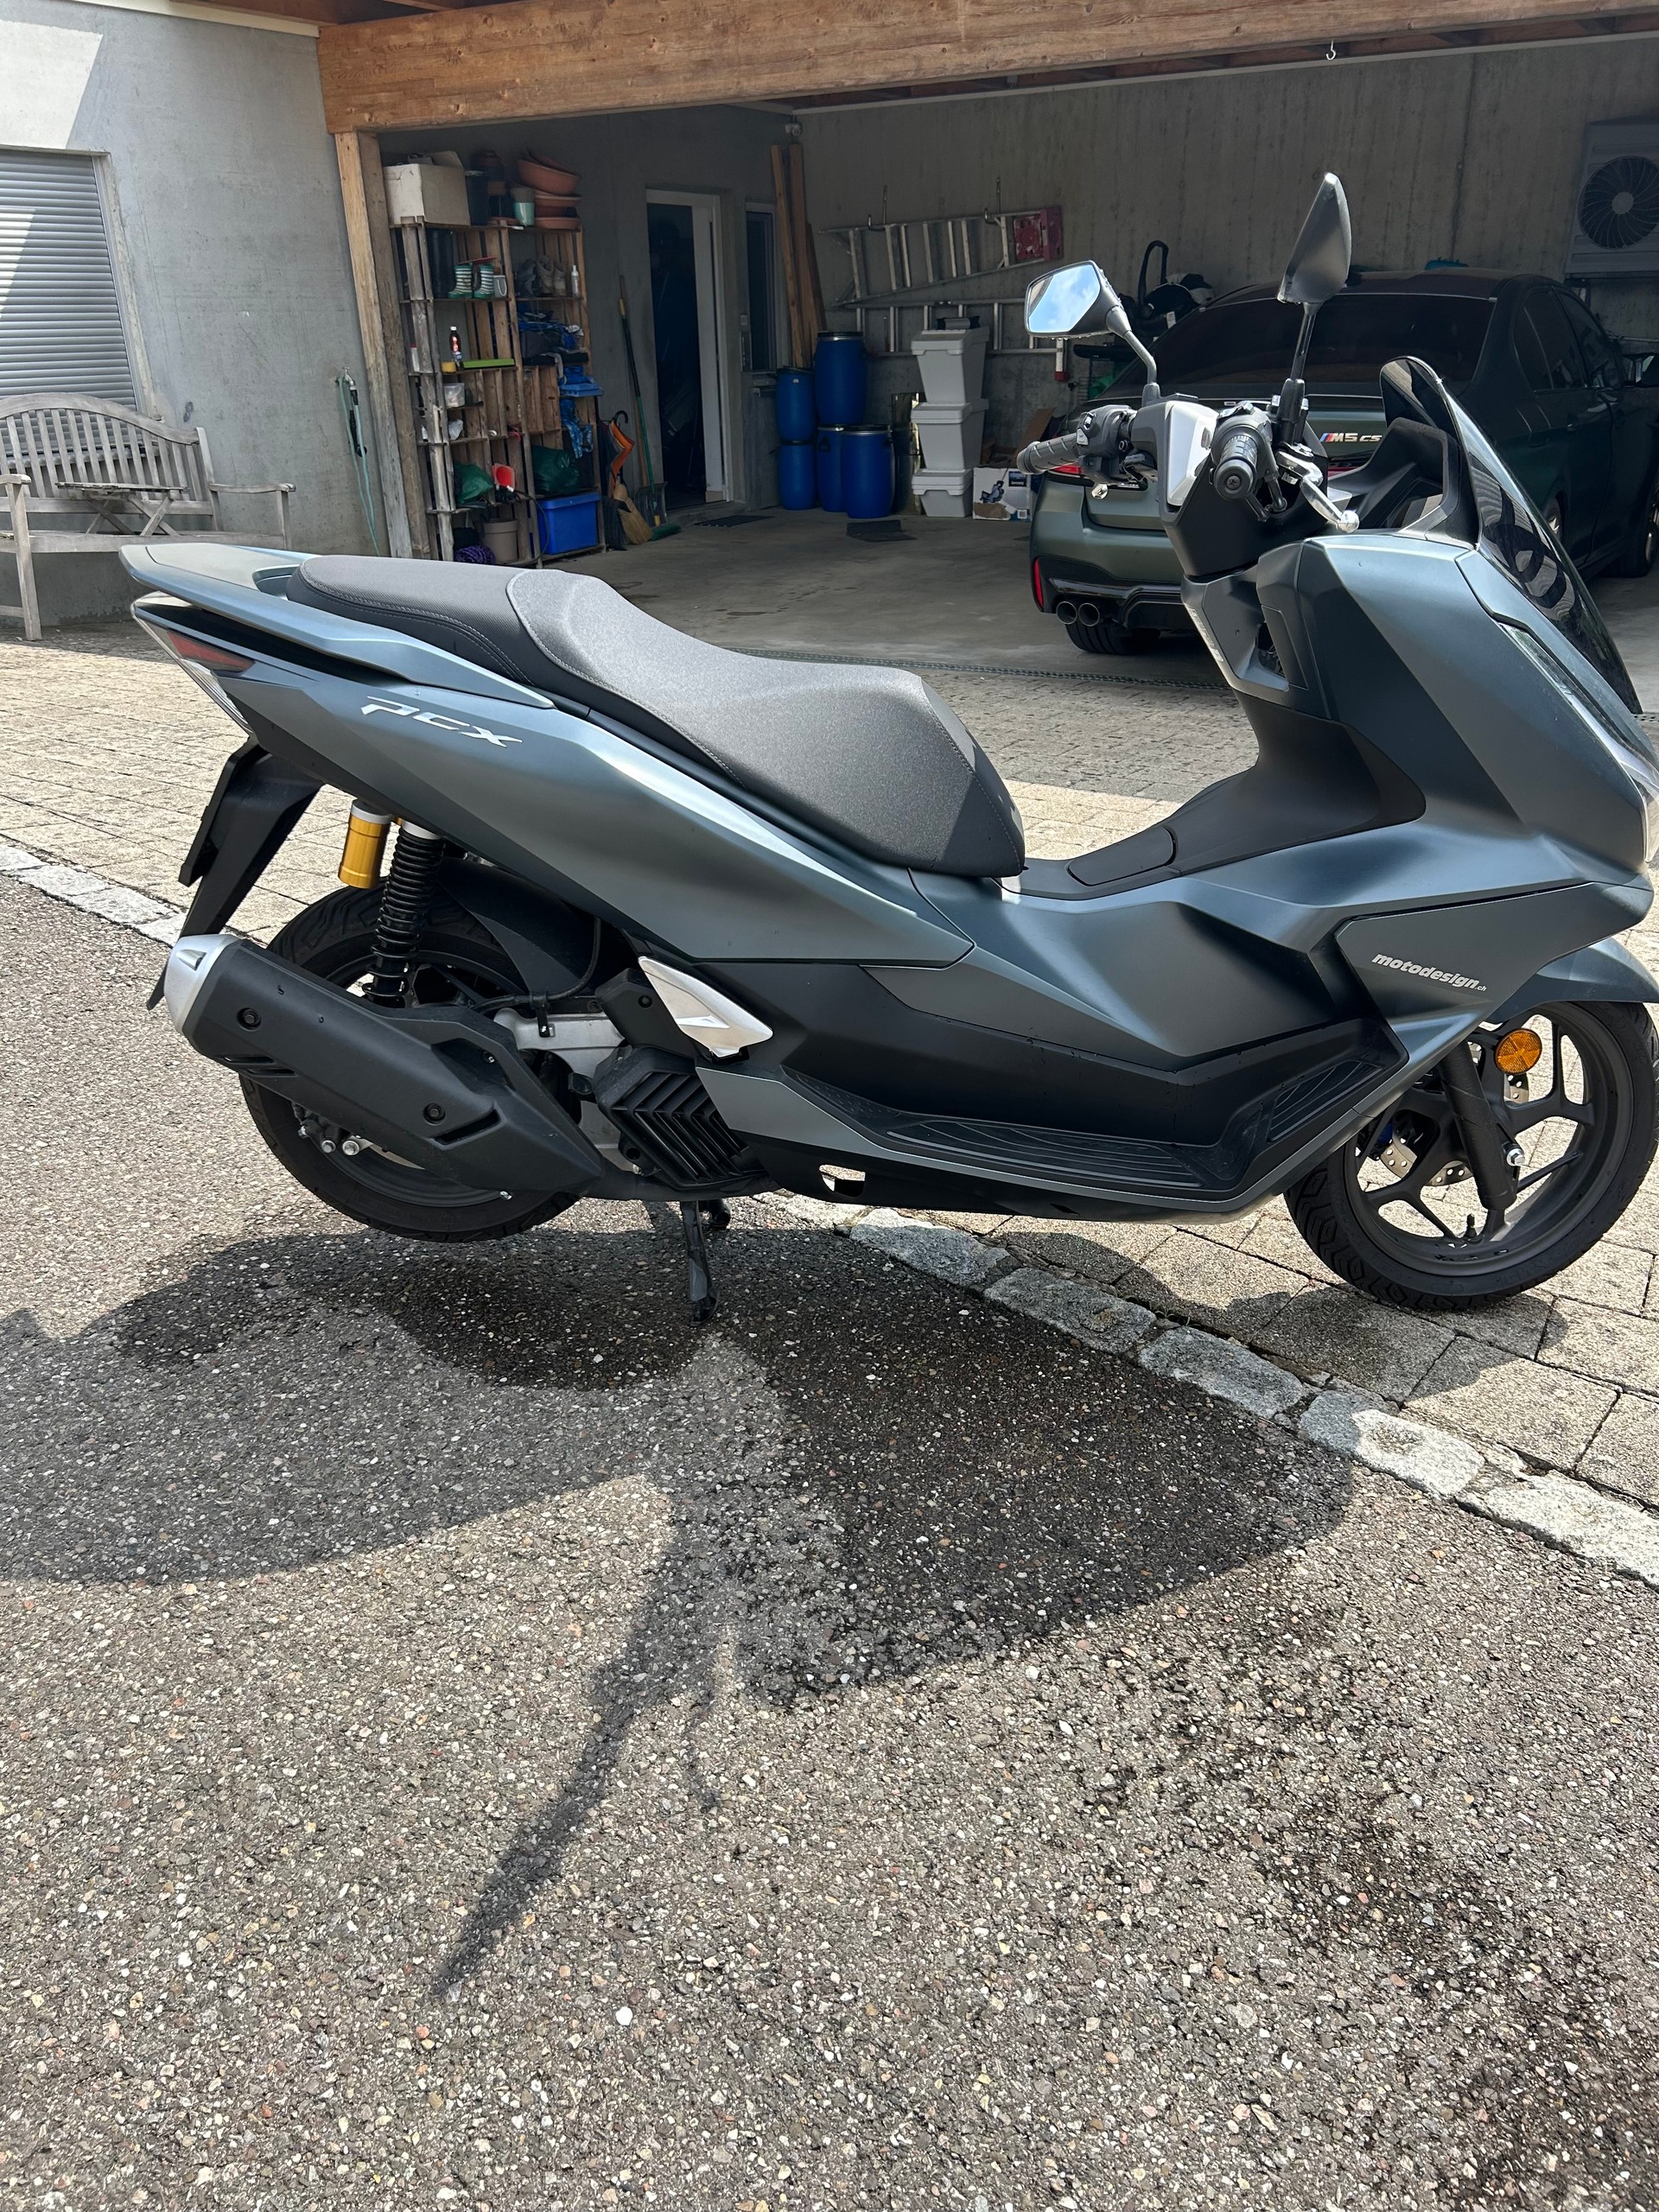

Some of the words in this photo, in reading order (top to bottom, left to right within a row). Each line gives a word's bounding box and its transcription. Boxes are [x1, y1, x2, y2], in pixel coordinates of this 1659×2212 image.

[1329, 433, 1358, 442] M5
[360, 696, 523, 748] PCX
[1371, 953, 1487, 992] motodesign.ch
